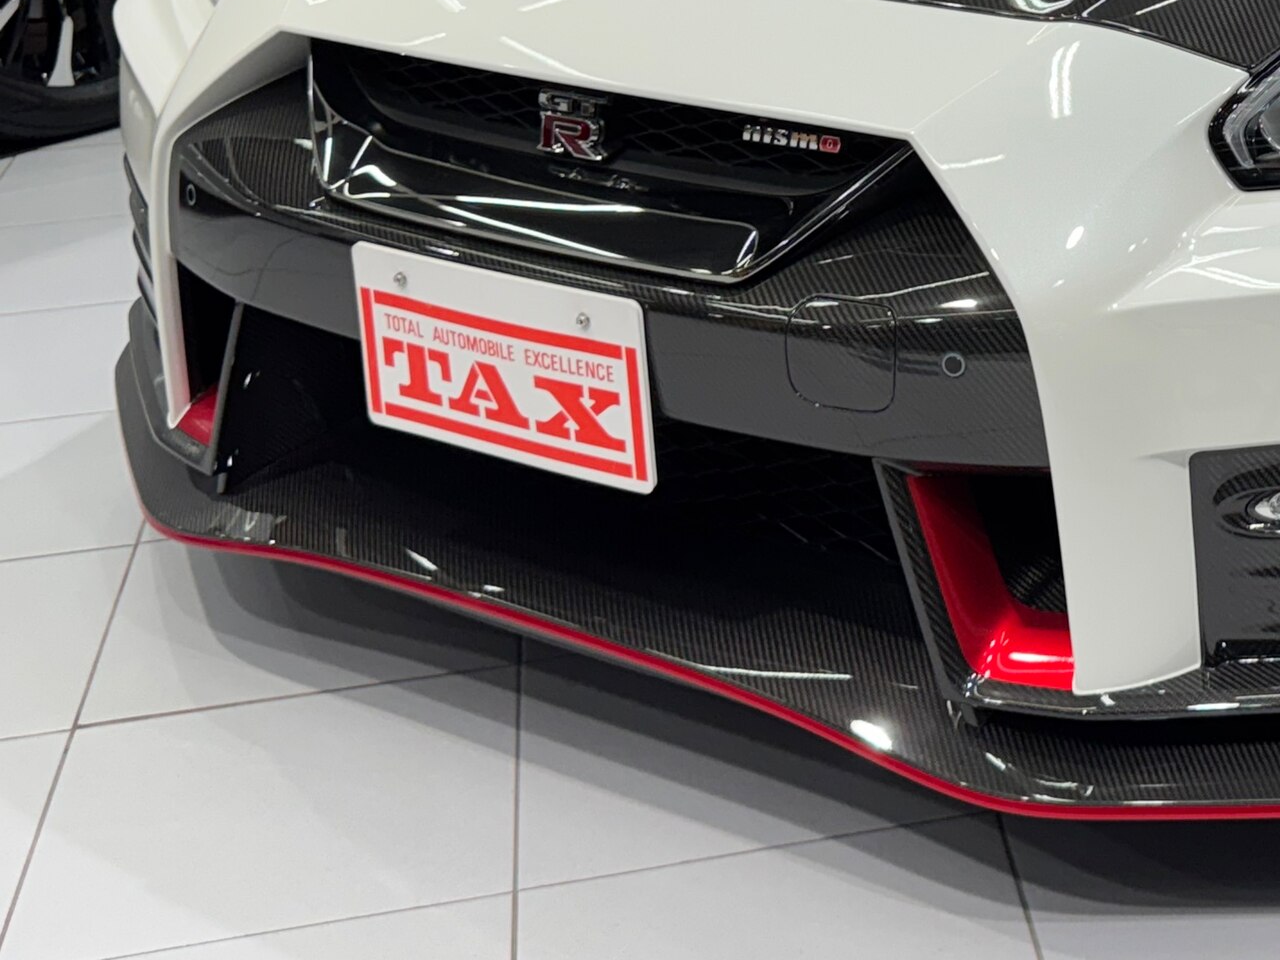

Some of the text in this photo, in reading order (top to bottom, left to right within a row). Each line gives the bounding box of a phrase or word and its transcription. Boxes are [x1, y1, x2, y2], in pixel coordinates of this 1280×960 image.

[381, 336, 627, 453] TAX
[384, 312, 615, 383] TOTAL AUTOMOBILE EXCELLENCE
